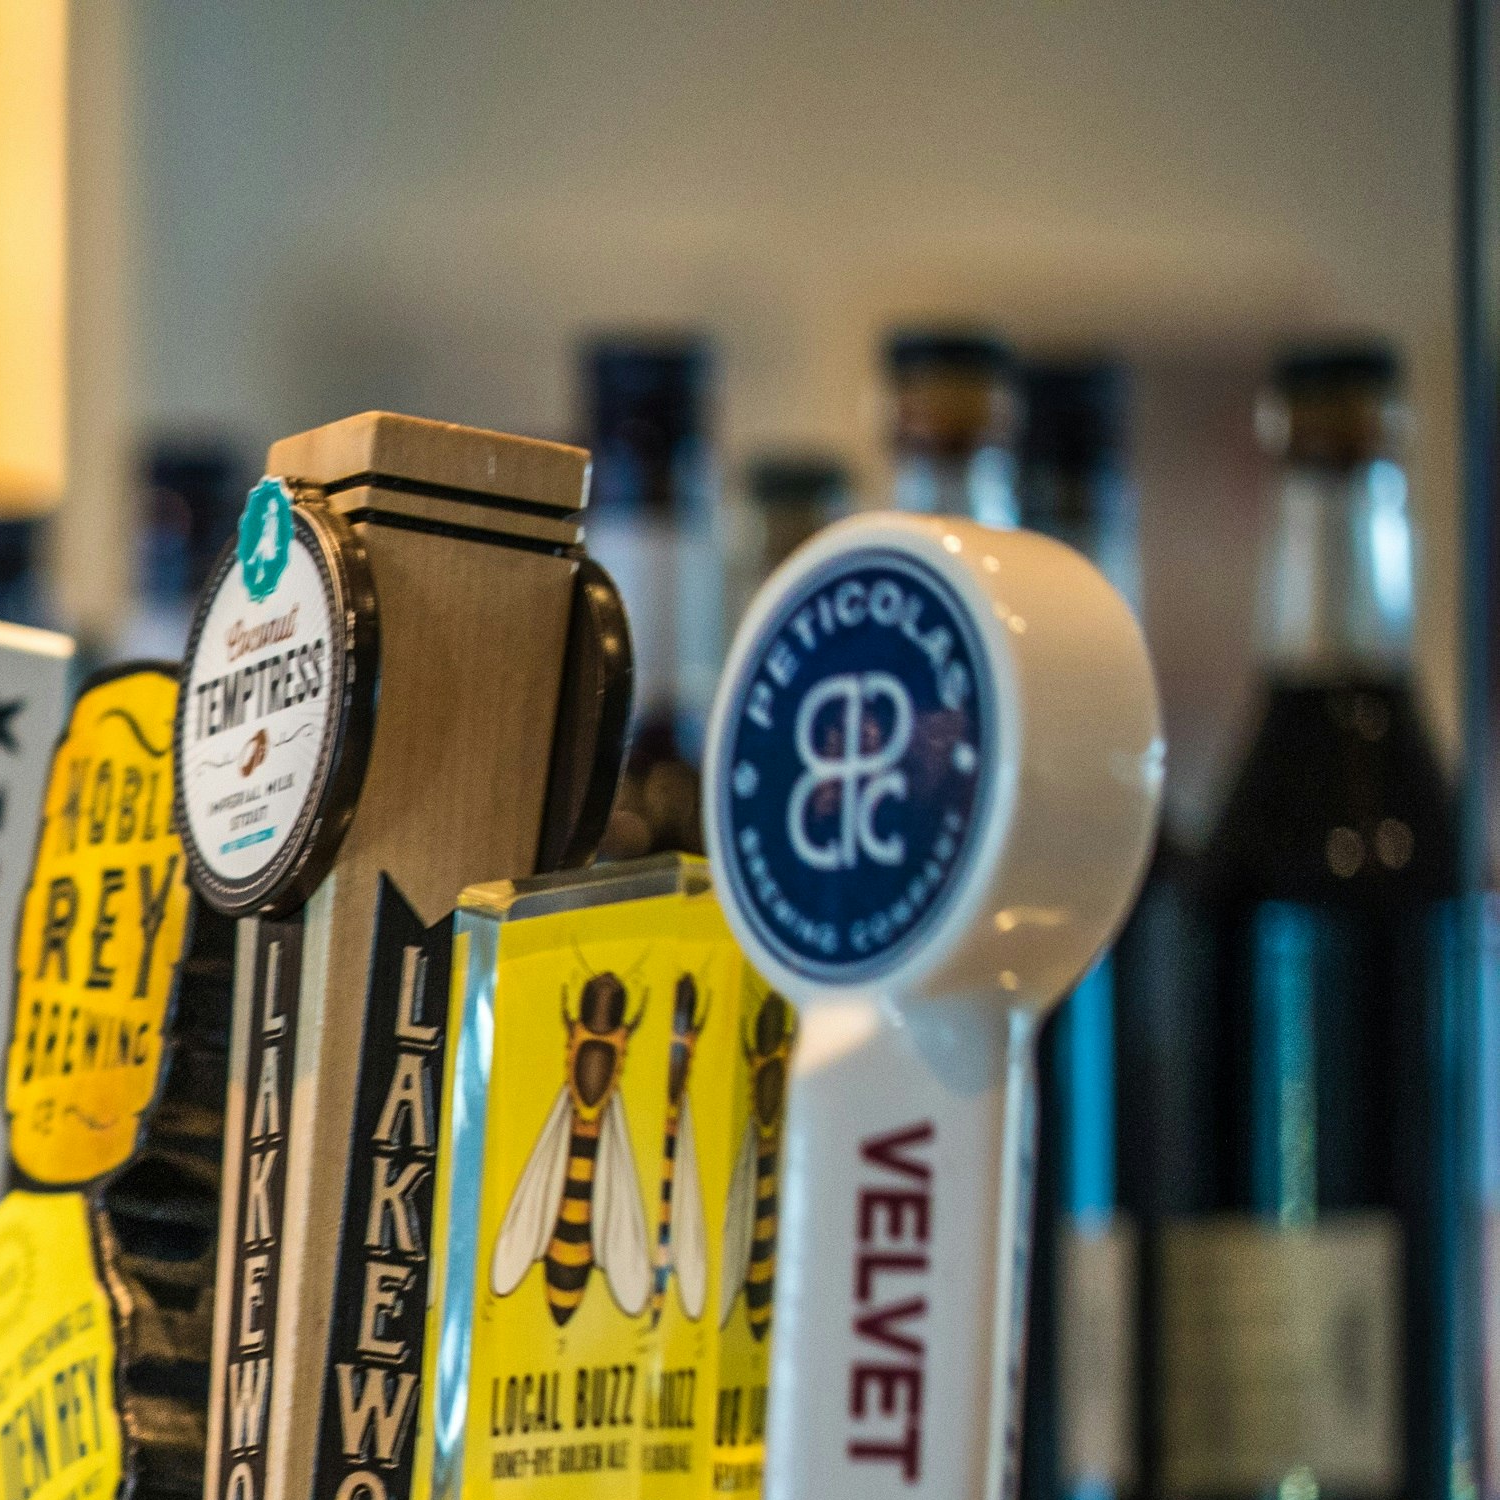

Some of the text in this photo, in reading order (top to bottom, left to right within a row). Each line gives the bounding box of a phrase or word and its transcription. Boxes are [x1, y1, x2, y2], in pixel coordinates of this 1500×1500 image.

[197, 638, 325, 741] TEMPTRESS
[746, 577, 970, 730] PETICOLAS
[54, 757, 179, 854] NOBL
[36, 853, 180, 999] REY
[22, 999, 150, 1084] BREWING
[847, 1118, 935, 1484] VELVET
[54, 1352, 104, 1469] REY
[490, 1370, 561, 1438] LOCAL
[574, 1362, 637, 1430] BUZZ
